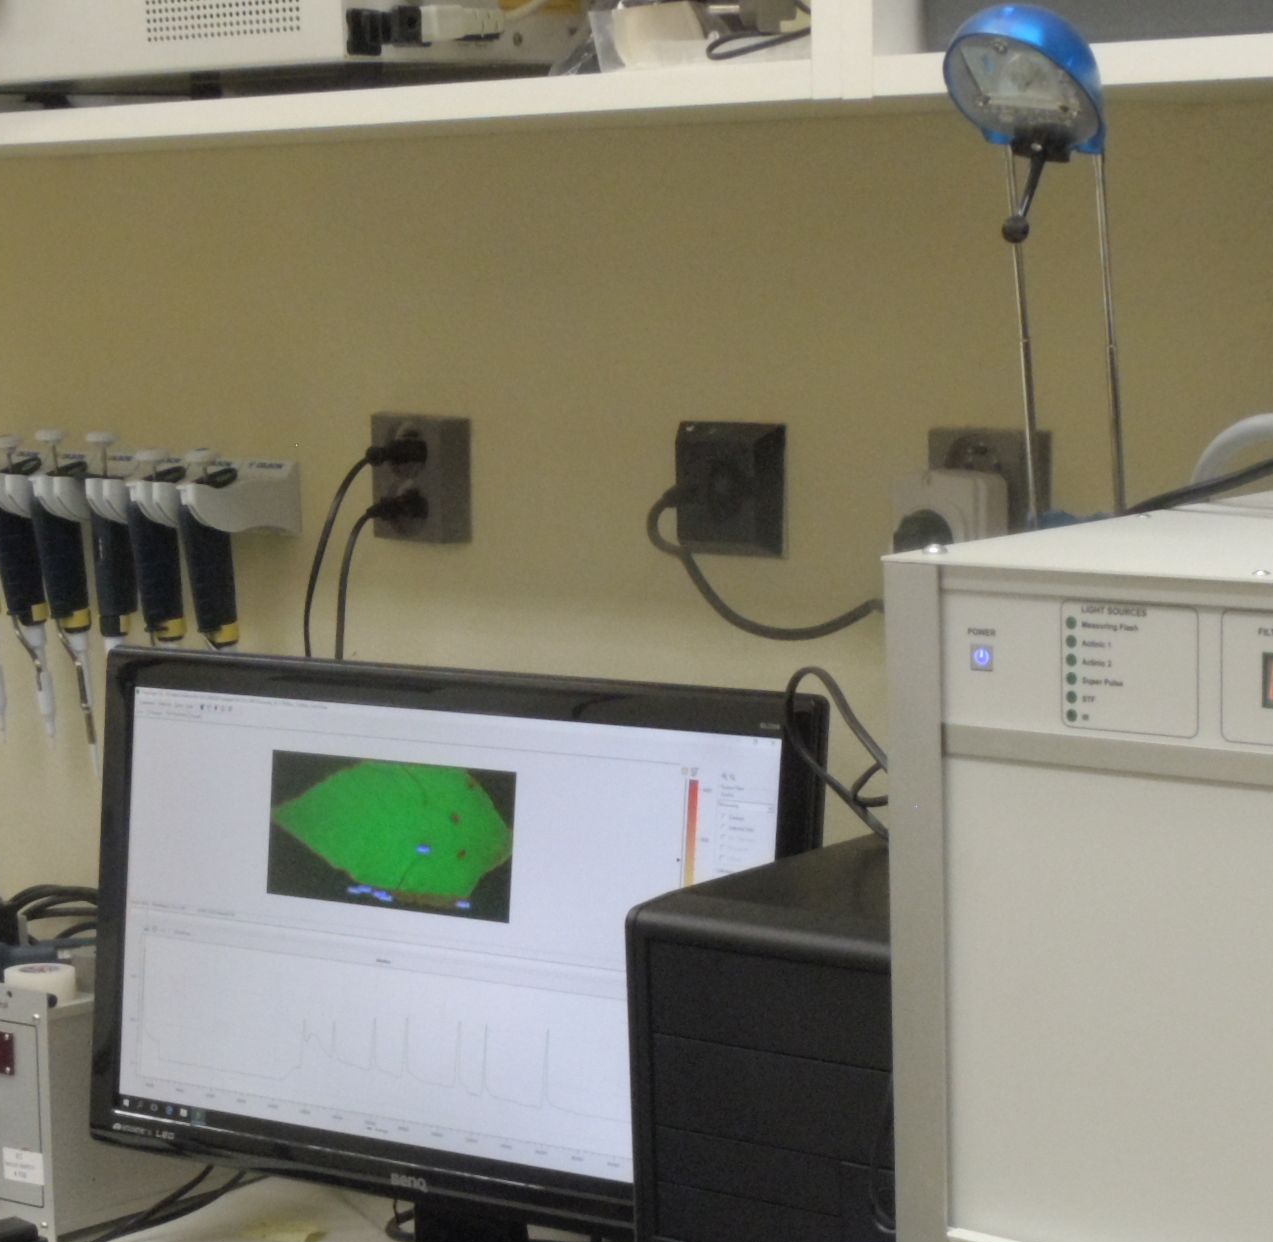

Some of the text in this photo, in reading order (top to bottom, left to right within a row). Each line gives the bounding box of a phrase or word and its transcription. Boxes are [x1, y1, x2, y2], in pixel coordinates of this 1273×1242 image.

[1081, 606, 1148, 618] LIGHT SOURCES
[967, 627, 996, 637] POWER
[1082, 621, 1139, 633] Measuring Flash
[1082, 639, 1106, 648] Actinic
[1082, 658, 1106, 667] Actinic
[1082, 676, 1124, 688] Super Pulse
